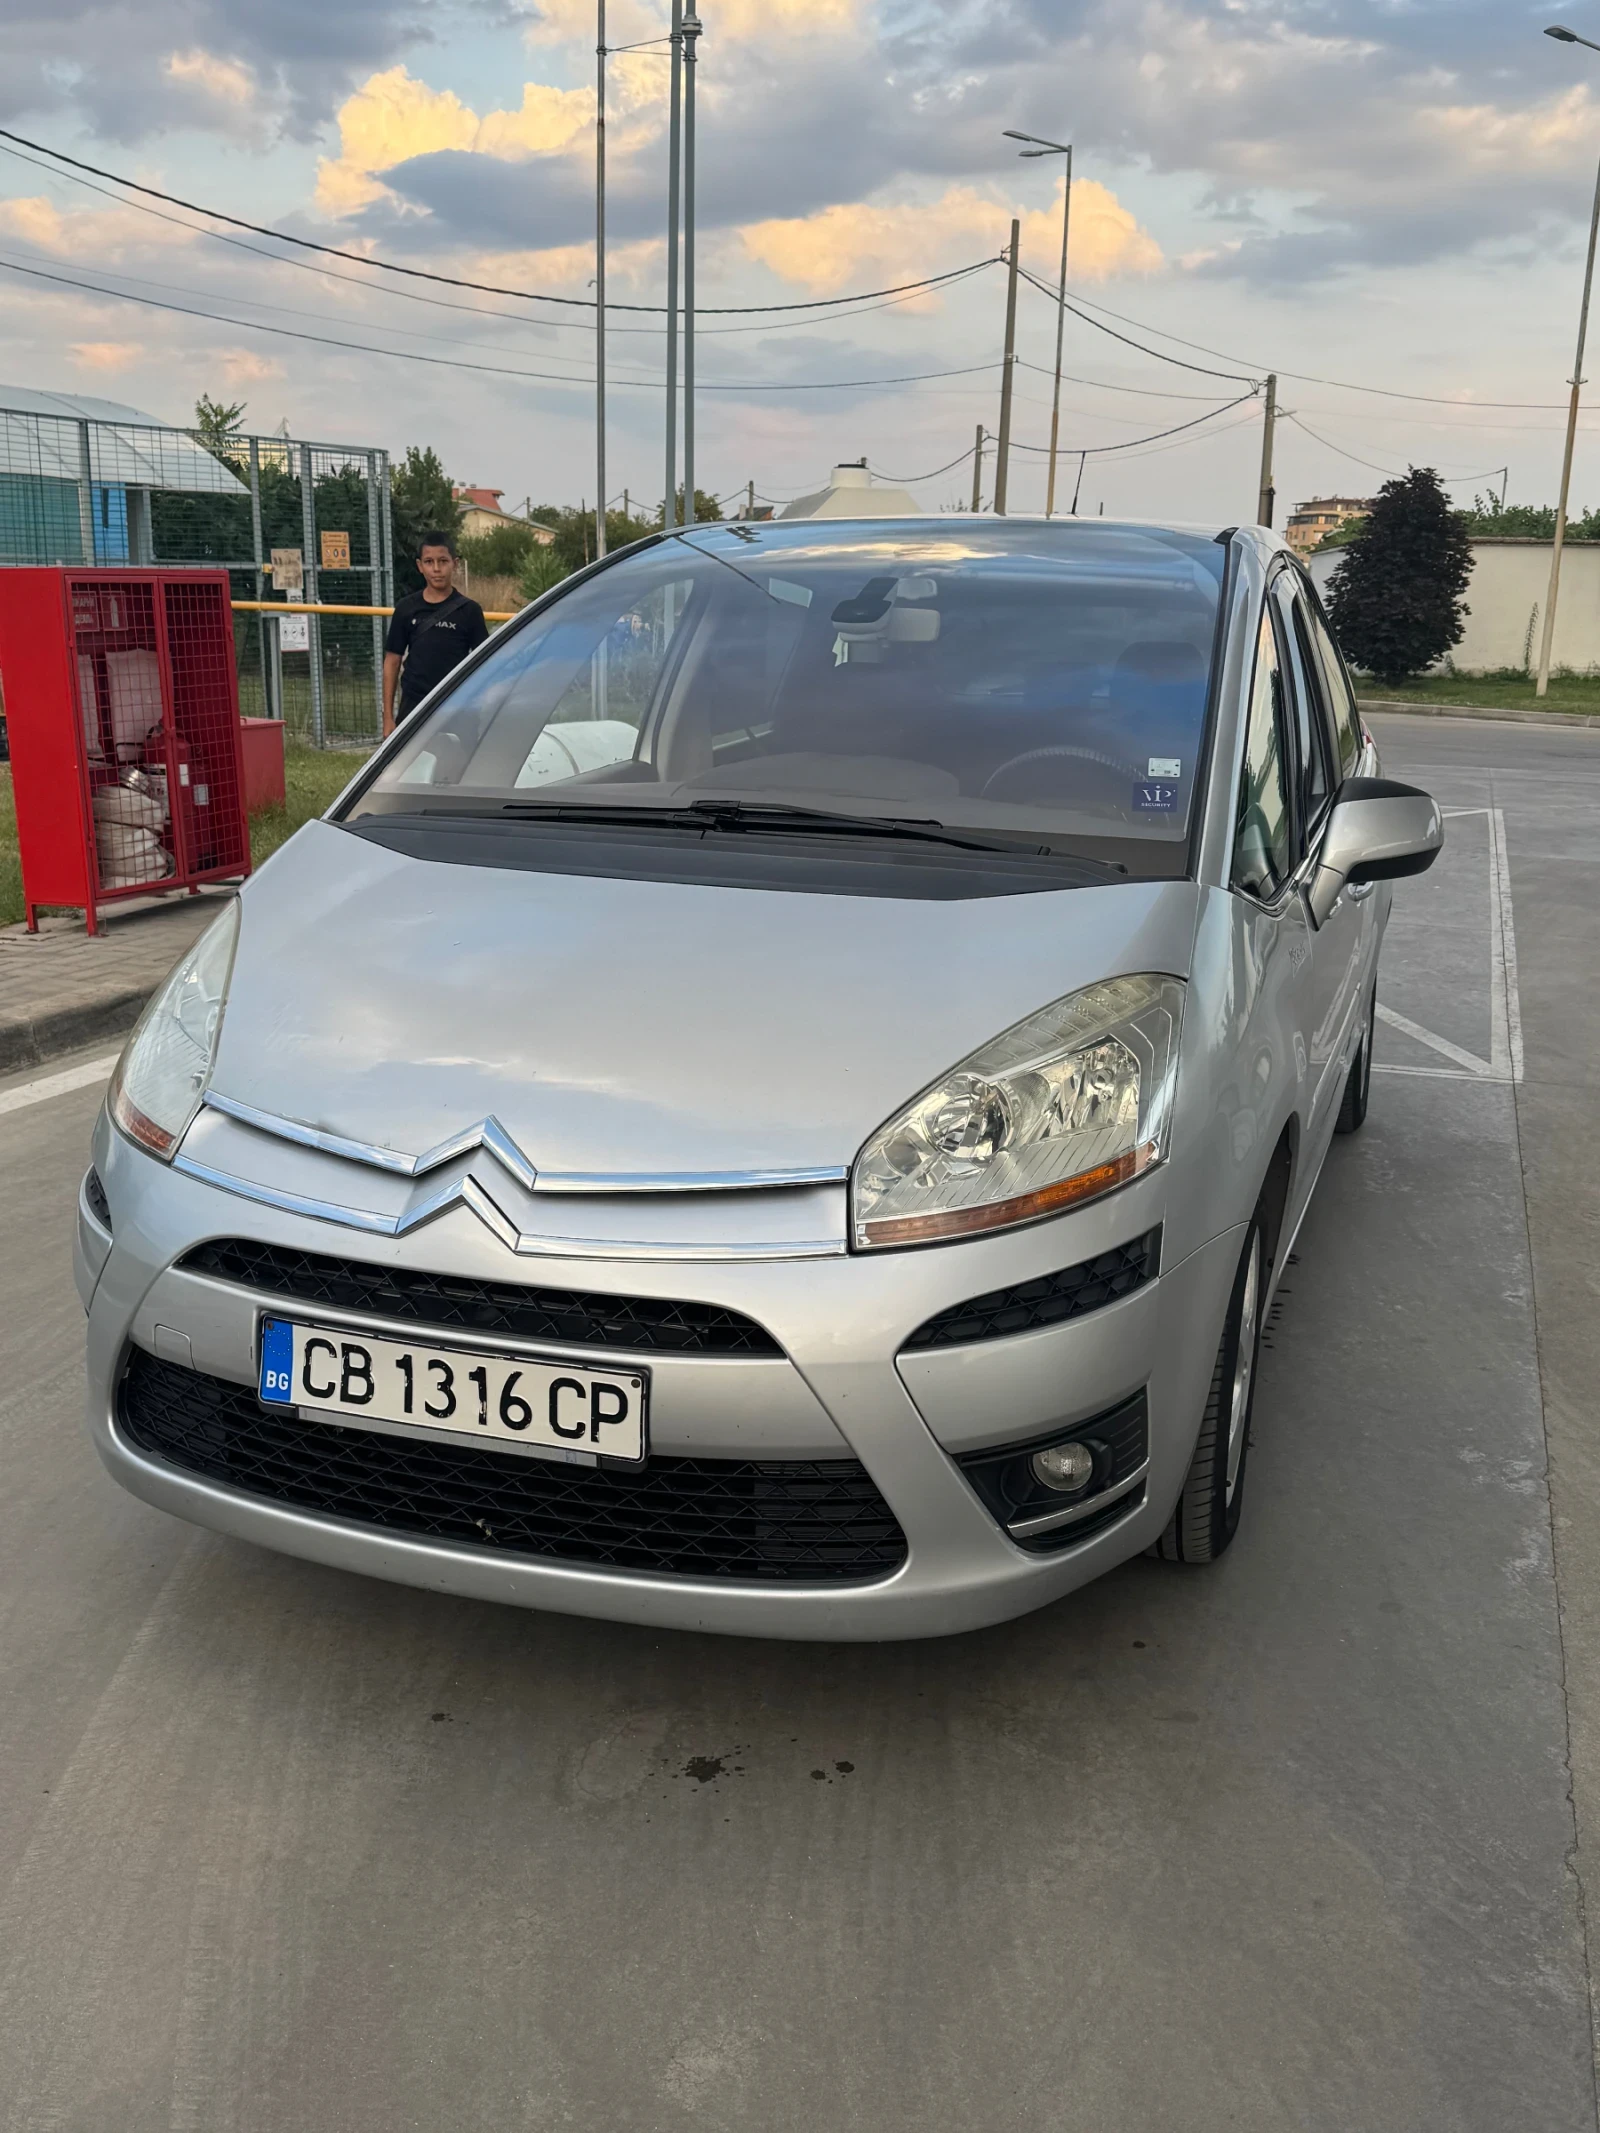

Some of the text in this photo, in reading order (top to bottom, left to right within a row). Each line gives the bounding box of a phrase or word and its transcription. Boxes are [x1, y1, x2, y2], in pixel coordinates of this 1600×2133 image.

[265, 1370, 289, 1391] BG
[302, 1337, 629, 1443] CB 1316 CP
